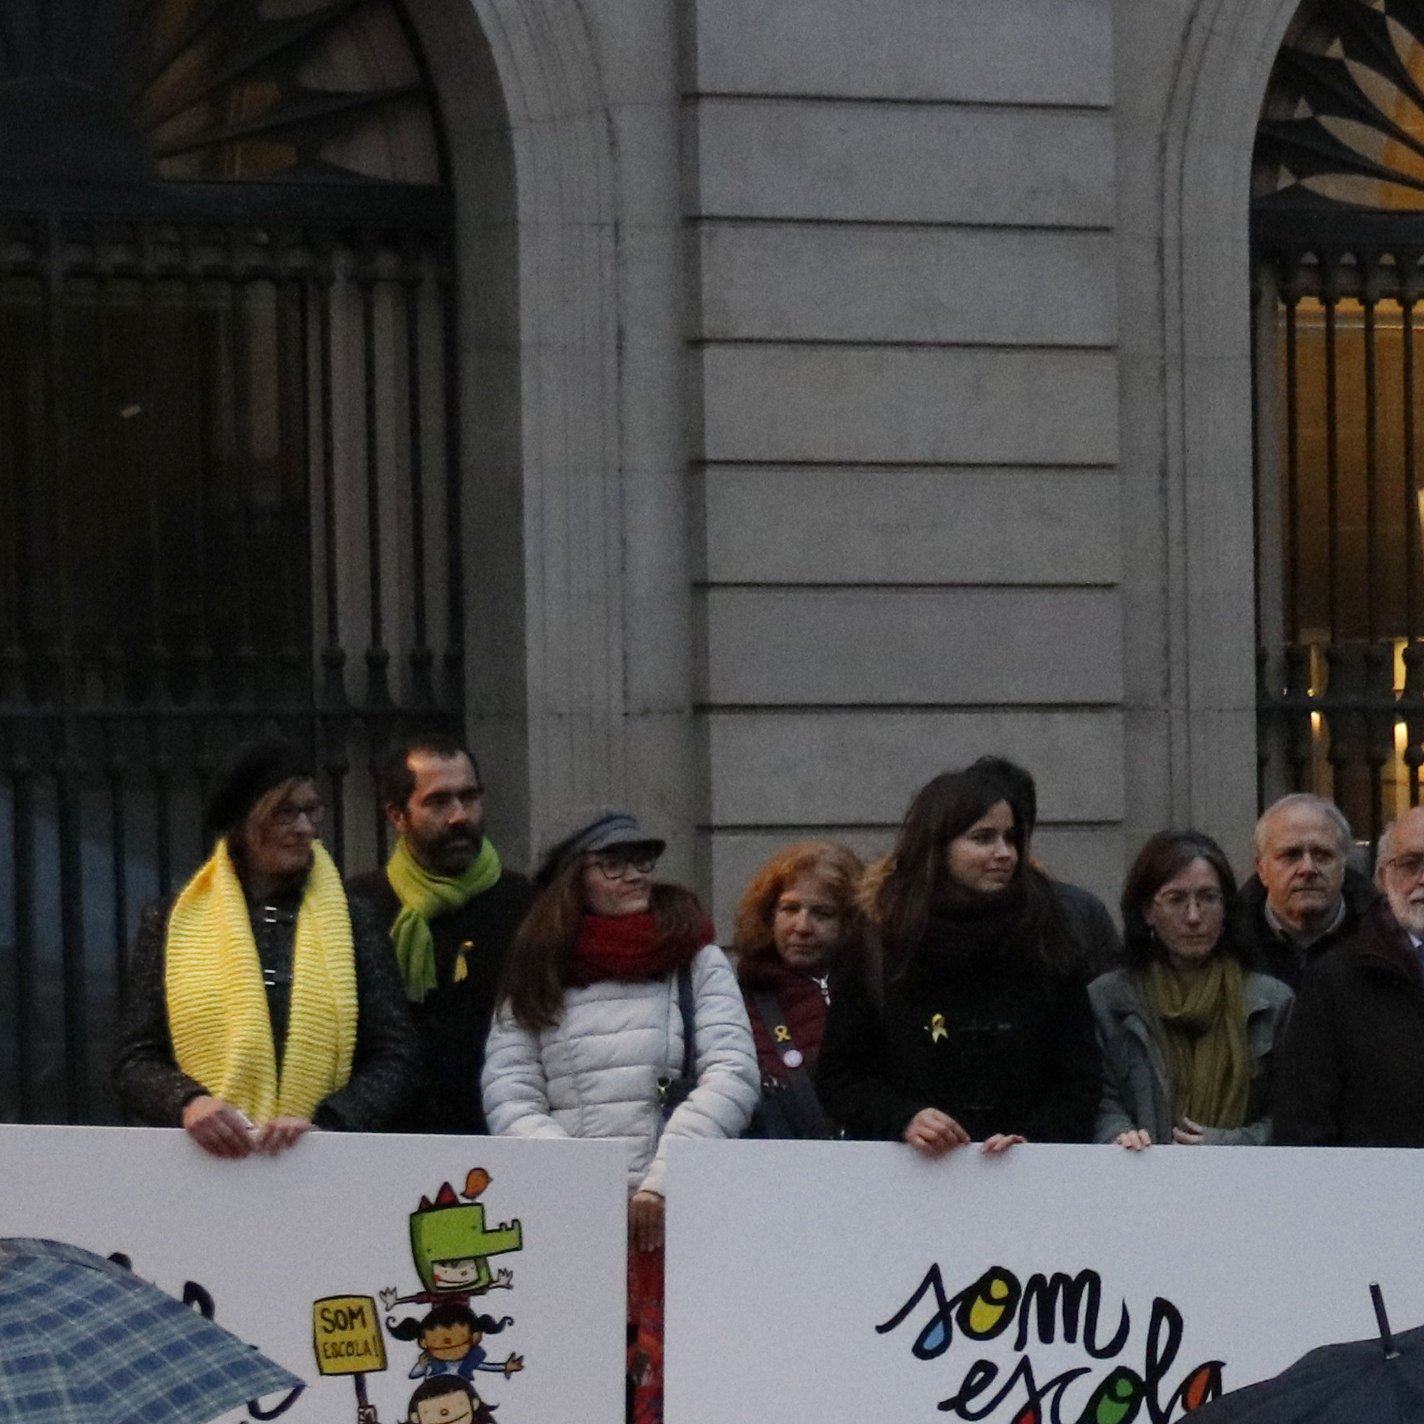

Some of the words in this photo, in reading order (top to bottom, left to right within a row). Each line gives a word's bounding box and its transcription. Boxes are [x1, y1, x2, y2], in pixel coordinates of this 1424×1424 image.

[321, 1306, 368, 1334] SOM
[875, 1262, 1130, 1360] som
[323, 1336, 379, 1359] ESCOLA!
